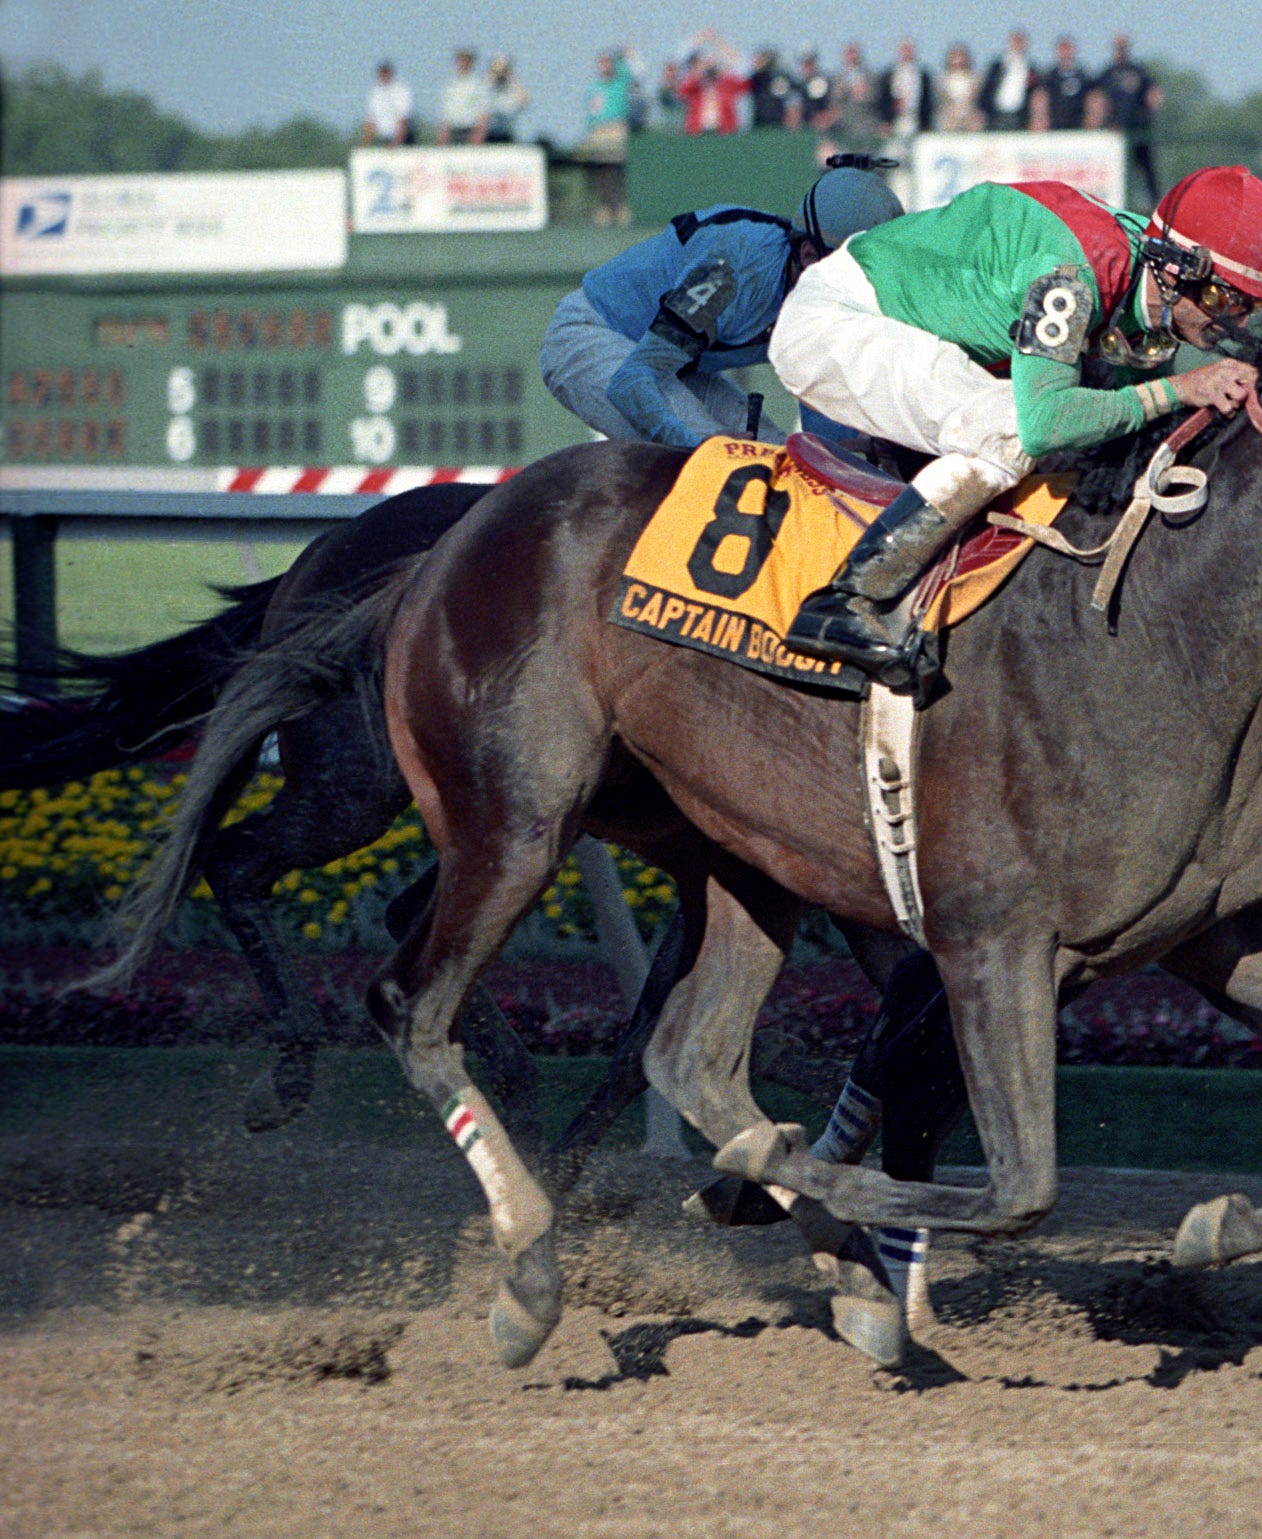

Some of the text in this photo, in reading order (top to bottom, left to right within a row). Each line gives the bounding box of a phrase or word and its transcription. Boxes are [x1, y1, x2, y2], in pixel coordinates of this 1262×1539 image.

[686, 280, 722, 314] 4
[1035, 287, 1077, 347] 8
[342, 302, 462, 355] POOL
[350, 415, 396, 464] 10
[686, 464, 791, 600] 8
[621, 583, 747, 652] CAPTAIN
